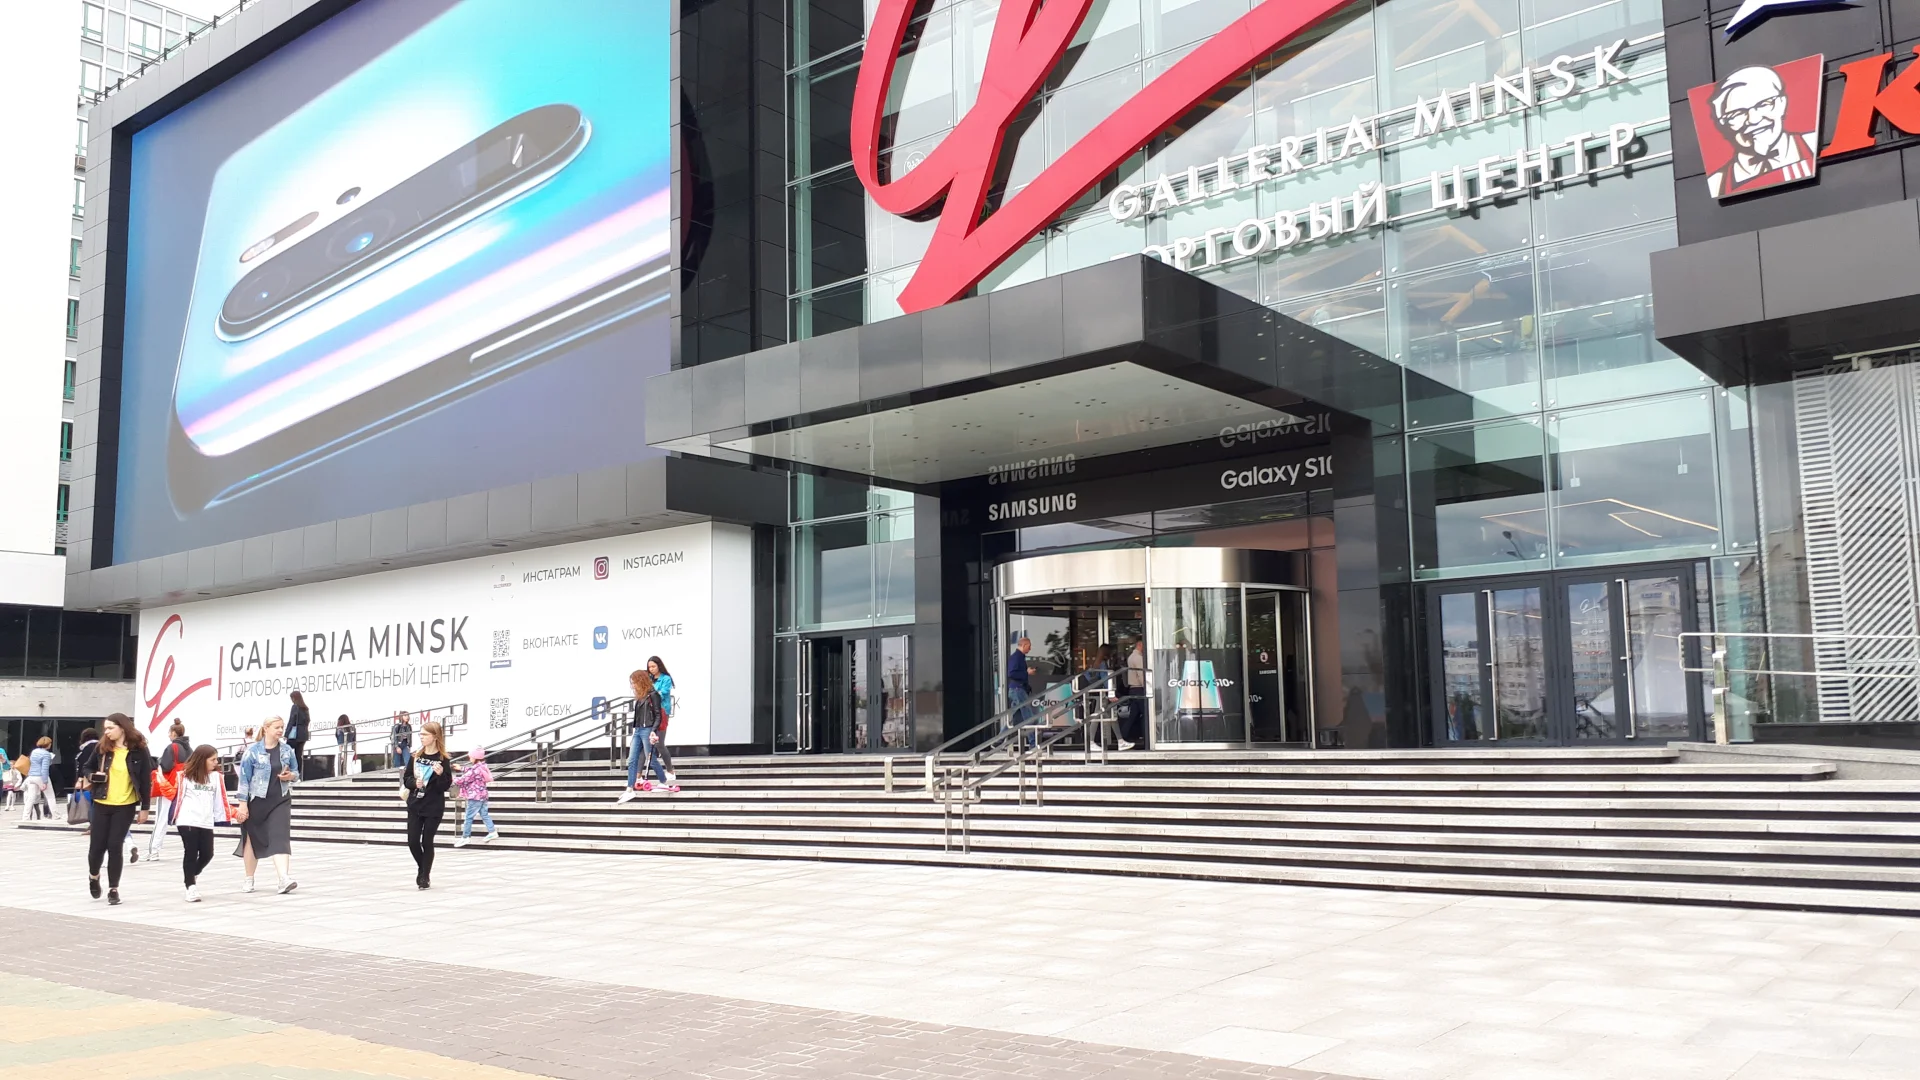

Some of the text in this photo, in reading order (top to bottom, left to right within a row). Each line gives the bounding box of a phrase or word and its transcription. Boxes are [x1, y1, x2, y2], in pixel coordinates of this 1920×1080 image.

[1109, 38, 1629, 220] GALLERIA MINSK
[1110, 122, 1635, 271] РГОВЫЙ ЦЕНТР
[1220, 463, 1301, 490] Galaxy
[988, 493, 1077, 521] SAMSUNG
[623, 551, 684, 570] INSTAGRAM
[522, 566, 581, 583] ИНСТАГРАМ
[621, 623, 683, 640] VKONTAKTE
[230, 616, 469, 672] GALLERIA MINSK
[522, 634, 579, 649] ВКОНТАКТЕ
[229, 662, 469, 699] ТОРГОВО-РАЗВЛЕКАТЕЛЬНЫЙ ЦЕНТР
[1168, 678, 1210, 689] Galaxy
[1249, 694, 1262, 703] 10+
[525, 704, 572, 717] ФЕЙСБУК
